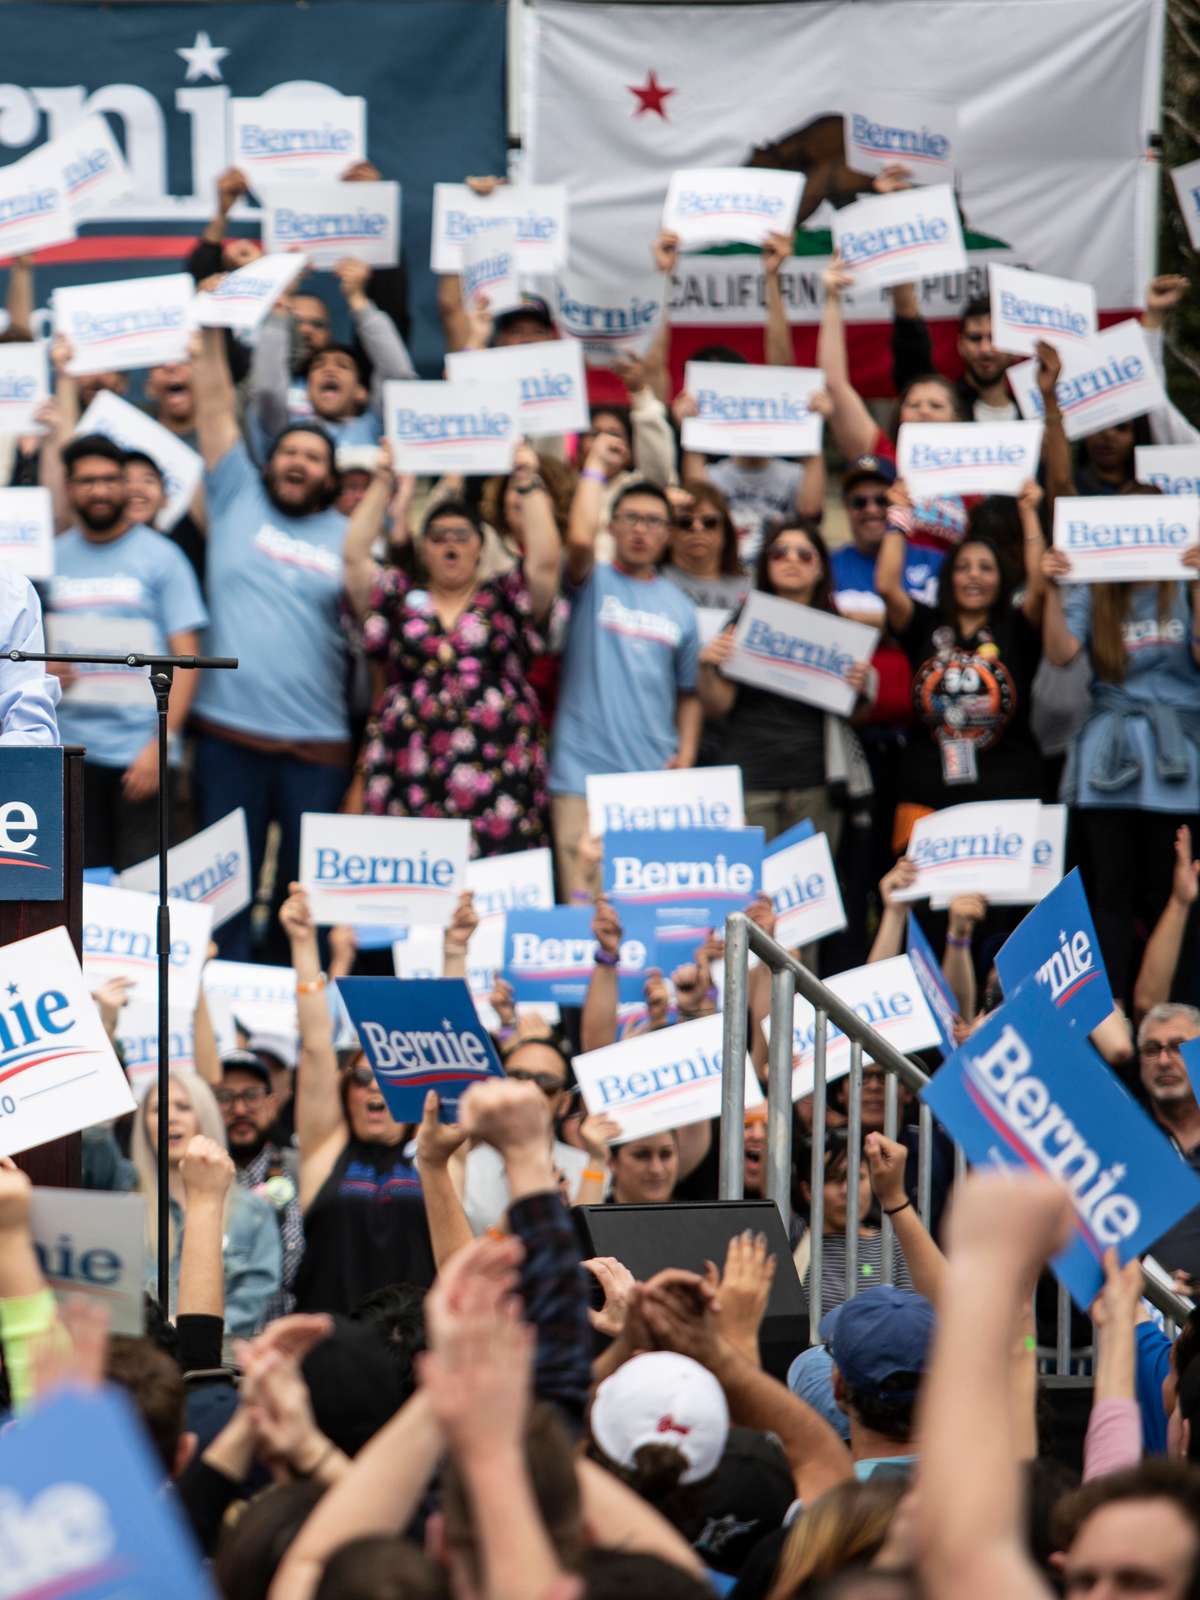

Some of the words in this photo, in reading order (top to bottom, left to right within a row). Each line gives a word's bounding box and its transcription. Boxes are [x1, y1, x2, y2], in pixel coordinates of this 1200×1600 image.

[239, 121, 354, 154] Bernie
[851, 112, 951, 160] Bernie
[273, 206, 389, 240] Bernie
[839, 211, 950, 264] Bernie
[999, 290, 1089, 335] Bernie
[519, 368, 574, 401] nie
[696, 386, 808, 414] Bernie
[395, 408, 513, 441] Bernie
[909, 440, 1027, 471] Bernie
[1066, 518, 1188, 549] Bernie
[745, 620, 857, 676] Bernie
[914, 826, 1023, 864] Bernie
[314, 847, 454, 887] Bernie
[612, 855, 753, 892] Bernie
[772, 869, 827, 913] nie
[83, 922, 191, 967] erne
[511, 933, 647, 970] Berne
[362, 1018, 490, 1070] Bernie
[974, 1024, 1140, 1244] Bernie
